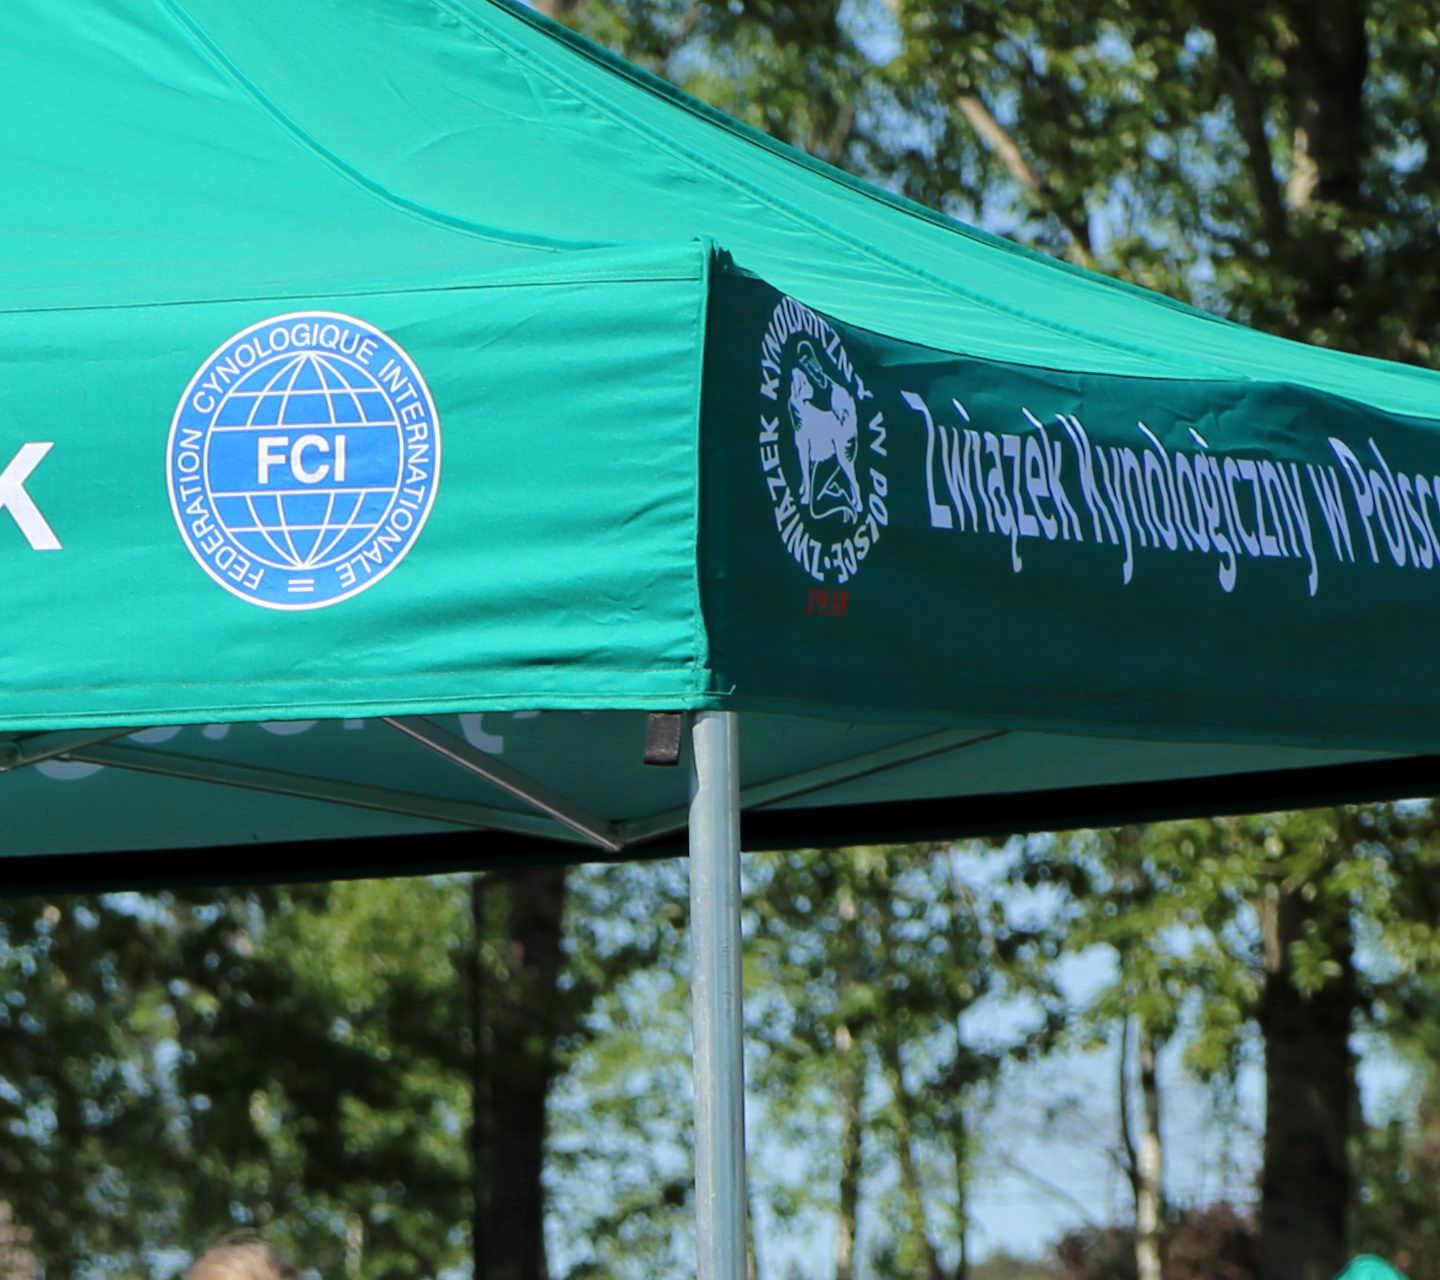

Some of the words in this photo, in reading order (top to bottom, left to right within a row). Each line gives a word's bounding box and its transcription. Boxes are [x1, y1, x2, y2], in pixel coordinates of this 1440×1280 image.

[192, 322, 379, 415] CYNOLOGIQUE
[256, 434, 346, 485] FCI
[335, 358, 429, 589] INTERNATIONALE
[869, 411, 887, 456] W
[177, 427, 265, 591] FEDERATION
[831, 467, 888, 584] POLSCE
[901, 390, 1083, 573] Związek
[1054, 413, 1318, 597] Kynologiczny
[1306, 464, 1355, 562] w
